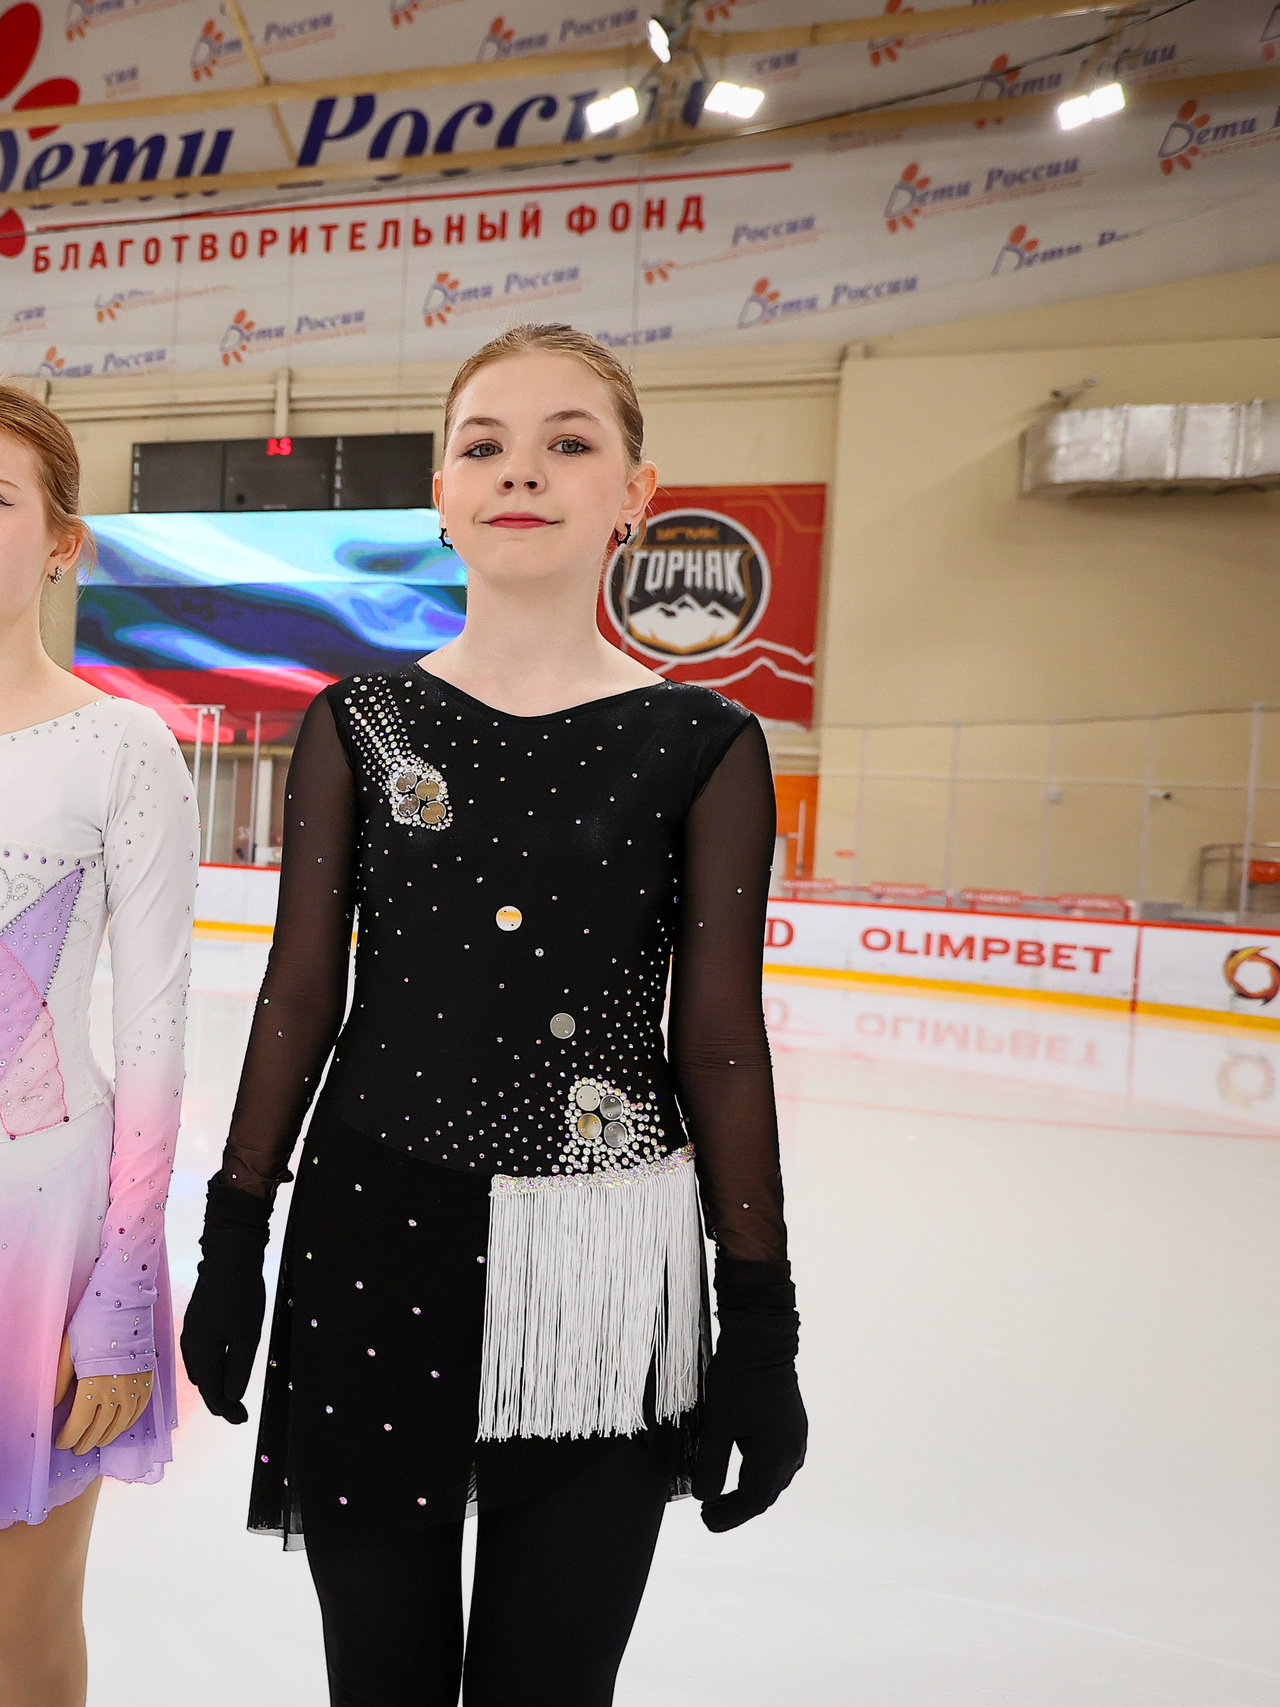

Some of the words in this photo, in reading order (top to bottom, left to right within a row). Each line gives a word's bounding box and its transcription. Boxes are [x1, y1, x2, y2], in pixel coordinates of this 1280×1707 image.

[984, 157, 1080, 193] России
[32, 202, 542, 273] БЛАГОТВОРИТЕЛЬНЫЙ
[566, 194, 706, 236] ФОНД
[625, 549, 747, 601] ГОРНЯК
[860, 926, 1113, 975] OLIMPBET
